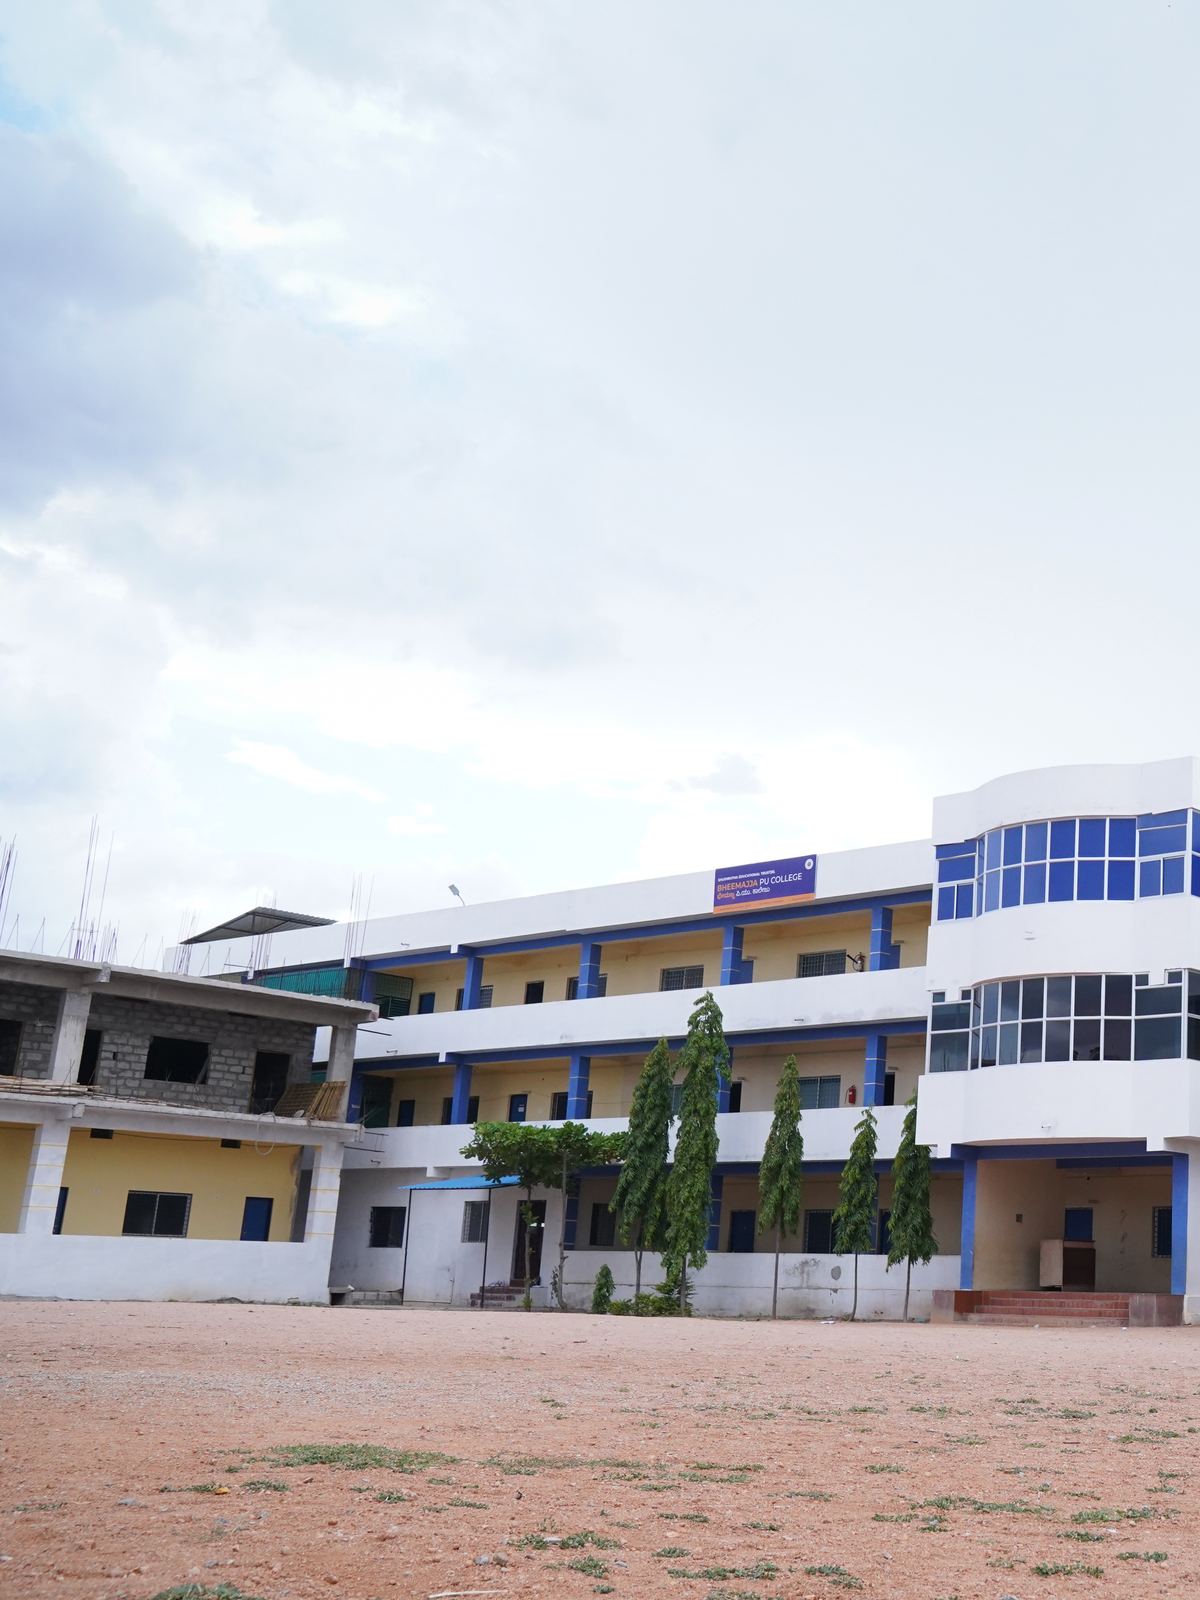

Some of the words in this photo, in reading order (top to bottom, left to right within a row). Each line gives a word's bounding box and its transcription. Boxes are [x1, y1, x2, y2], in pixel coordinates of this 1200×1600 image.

[717, 880, 758, 892] BHEEMAJJA
[759, 876, 770, 886] PU
[770, 872, 802, 884] COLLEGE
